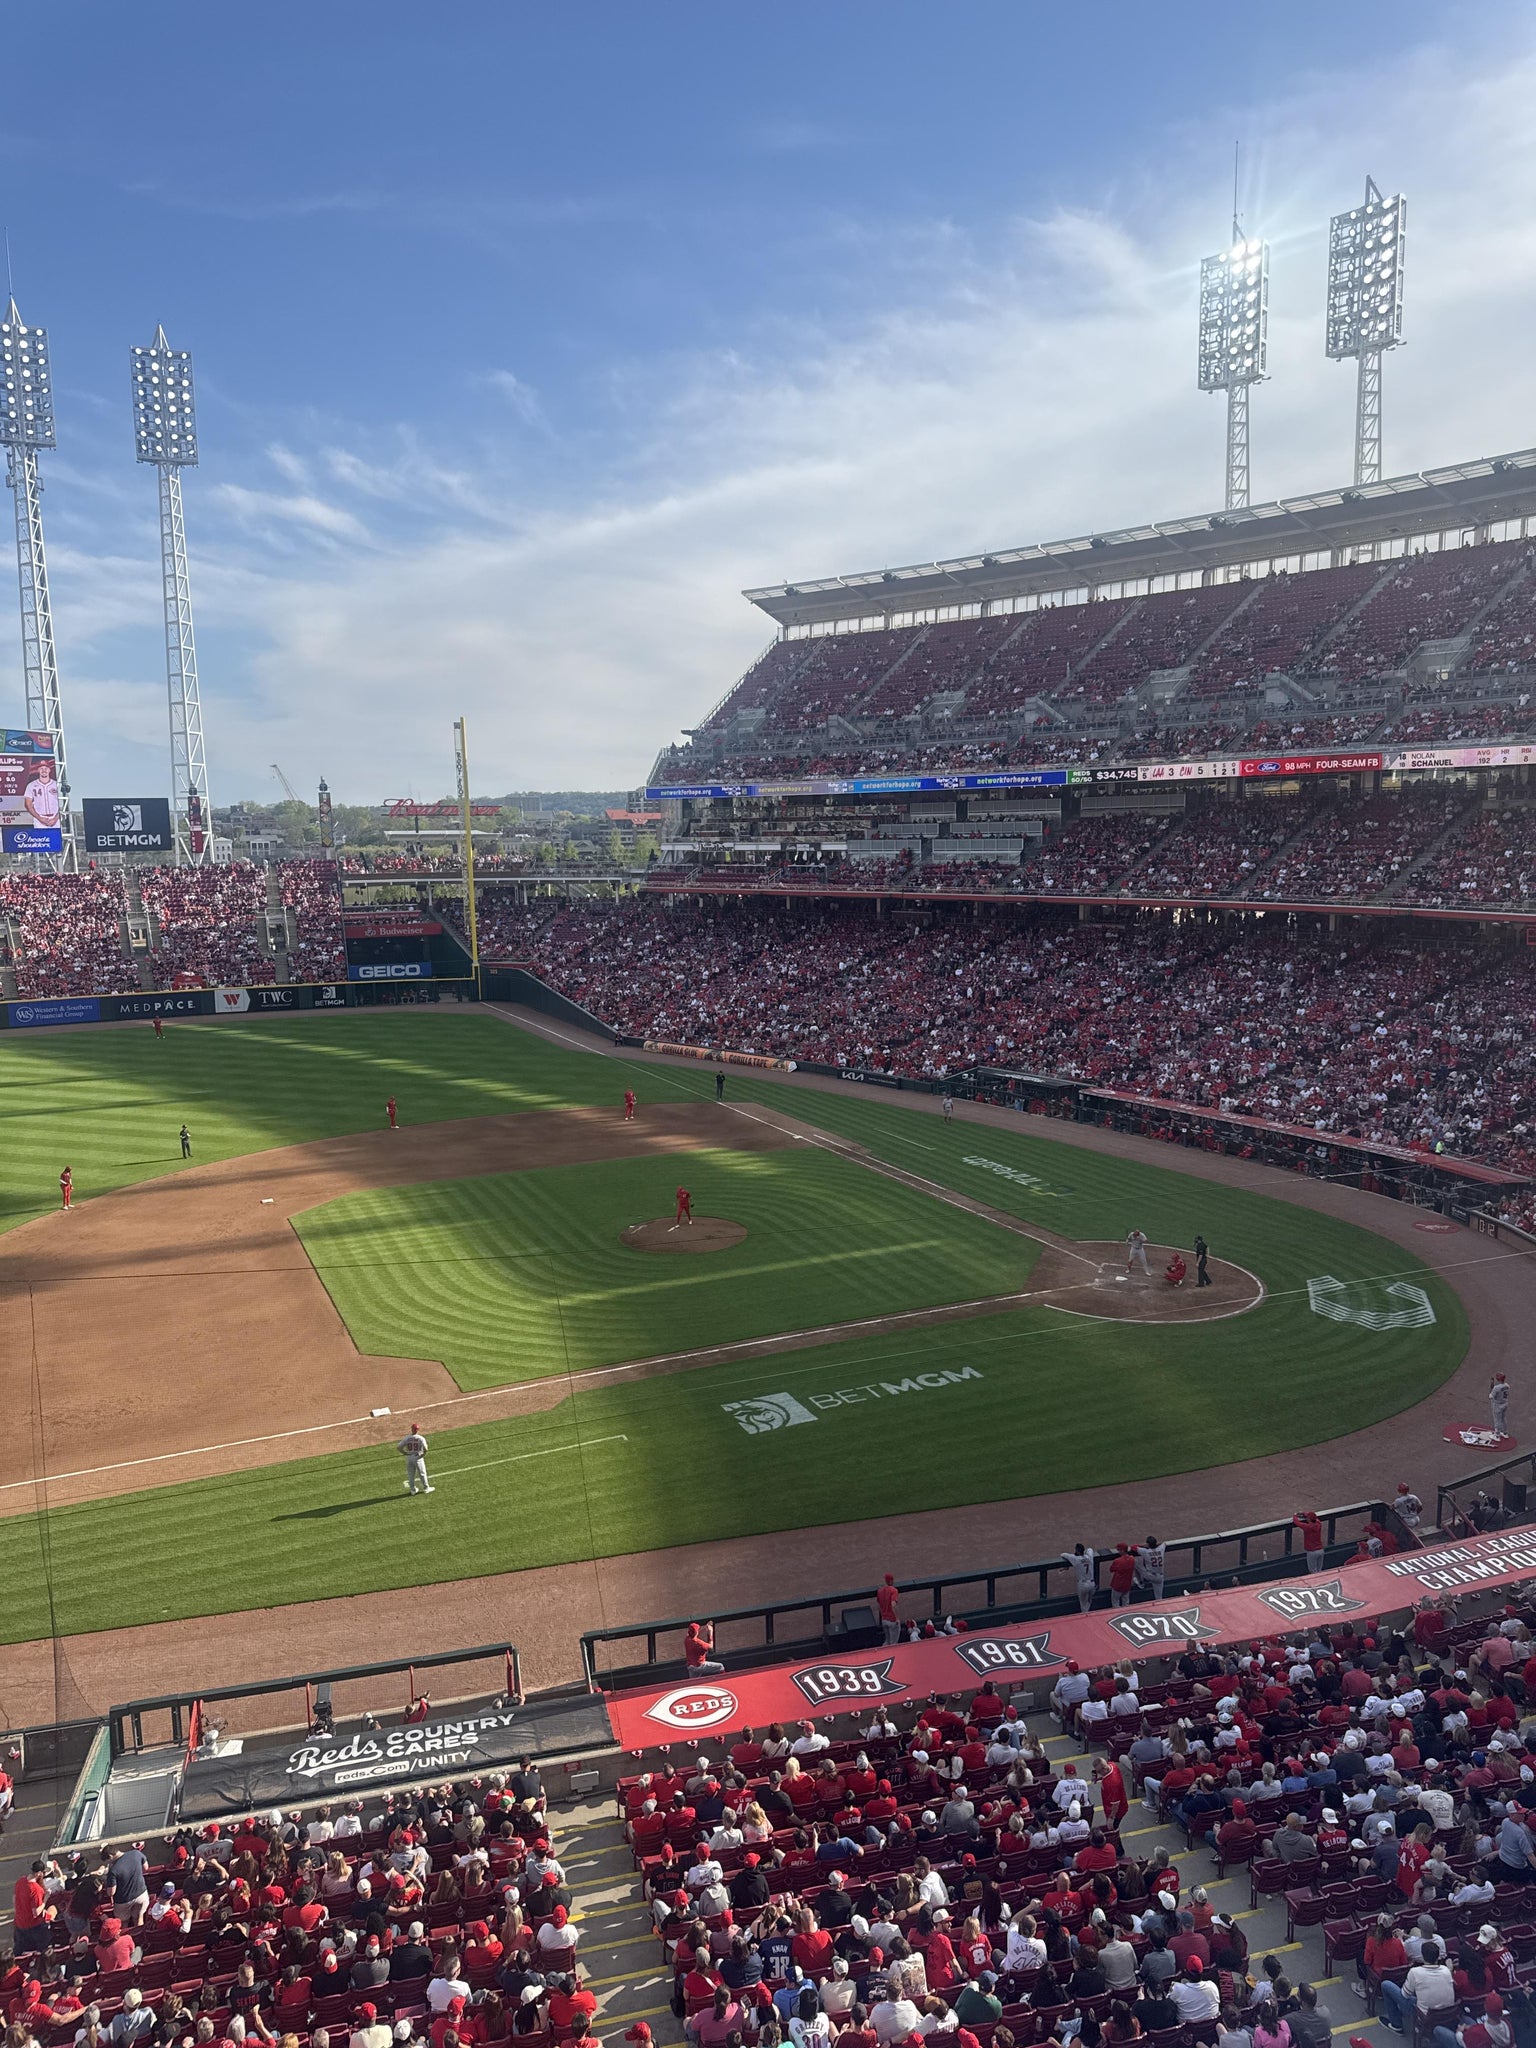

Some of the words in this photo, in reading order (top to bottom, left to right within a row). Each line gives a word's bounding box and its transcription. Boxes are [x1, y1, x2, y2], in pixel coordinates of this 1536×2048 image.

[1411, 752, 1435, 760] NOLAN
[1284, 762, 1295, 771] 98
[1296, 762, 1311, 770] MPH
[1316, 758, 1366, 769] FOUR-SEAM
[1367, 758, 1379, 767] FB
[1411, 759, 1454, 768] SCHANUEL
[1096, 769, 1137, 781] $34,745
[1142, 772, 1147, 780] 5
[1168, 767, 1175, 777] 3
[1197, 766, 1204, 775] 5
[1221, 768, 1227, 776] 2
[862, 781, 921, 790] networkforhope.org
[976, 775, 1043, 785] networkforhope.org
[97, 834, 161, 847] BETMGM
[379, 926, 424, 936] Budweiser
[358, 964, 421, 978] GEICO
[258, 990, 293, 1004] TWC
[315, 999, 345, 1007] BETMGM
[34, 1005, 58, 1013] Western
[66, 1004, 93, 1012] Southern
[120, 999, 195, 1013] MEDPACE
[64, 1011, 84, 1019] Group
[661, 1044, 683, 1055] GORILLA
[728, 1054, 750, 1066] GORILLA
[807, 1366, 985, 1410] BETMGM
[1150, 1557, 1164, 1568] 22
[1384, 1546, 1482, 1577] NATIONAL
[1268, 1586, 1347, 1614] 1972
[1120, 1613, 1198, 1642] 1970
[966, 1639, 1045, 1667] 1961
[799, 1667, 882, 1698] 1939
[673, 1695, 734, 1716] REDS
[386, 1713, 515, 1746] COUNTRY
[386, 1731, 480, 1758] CARES
[284, 1734, 384, 1778] Reds
